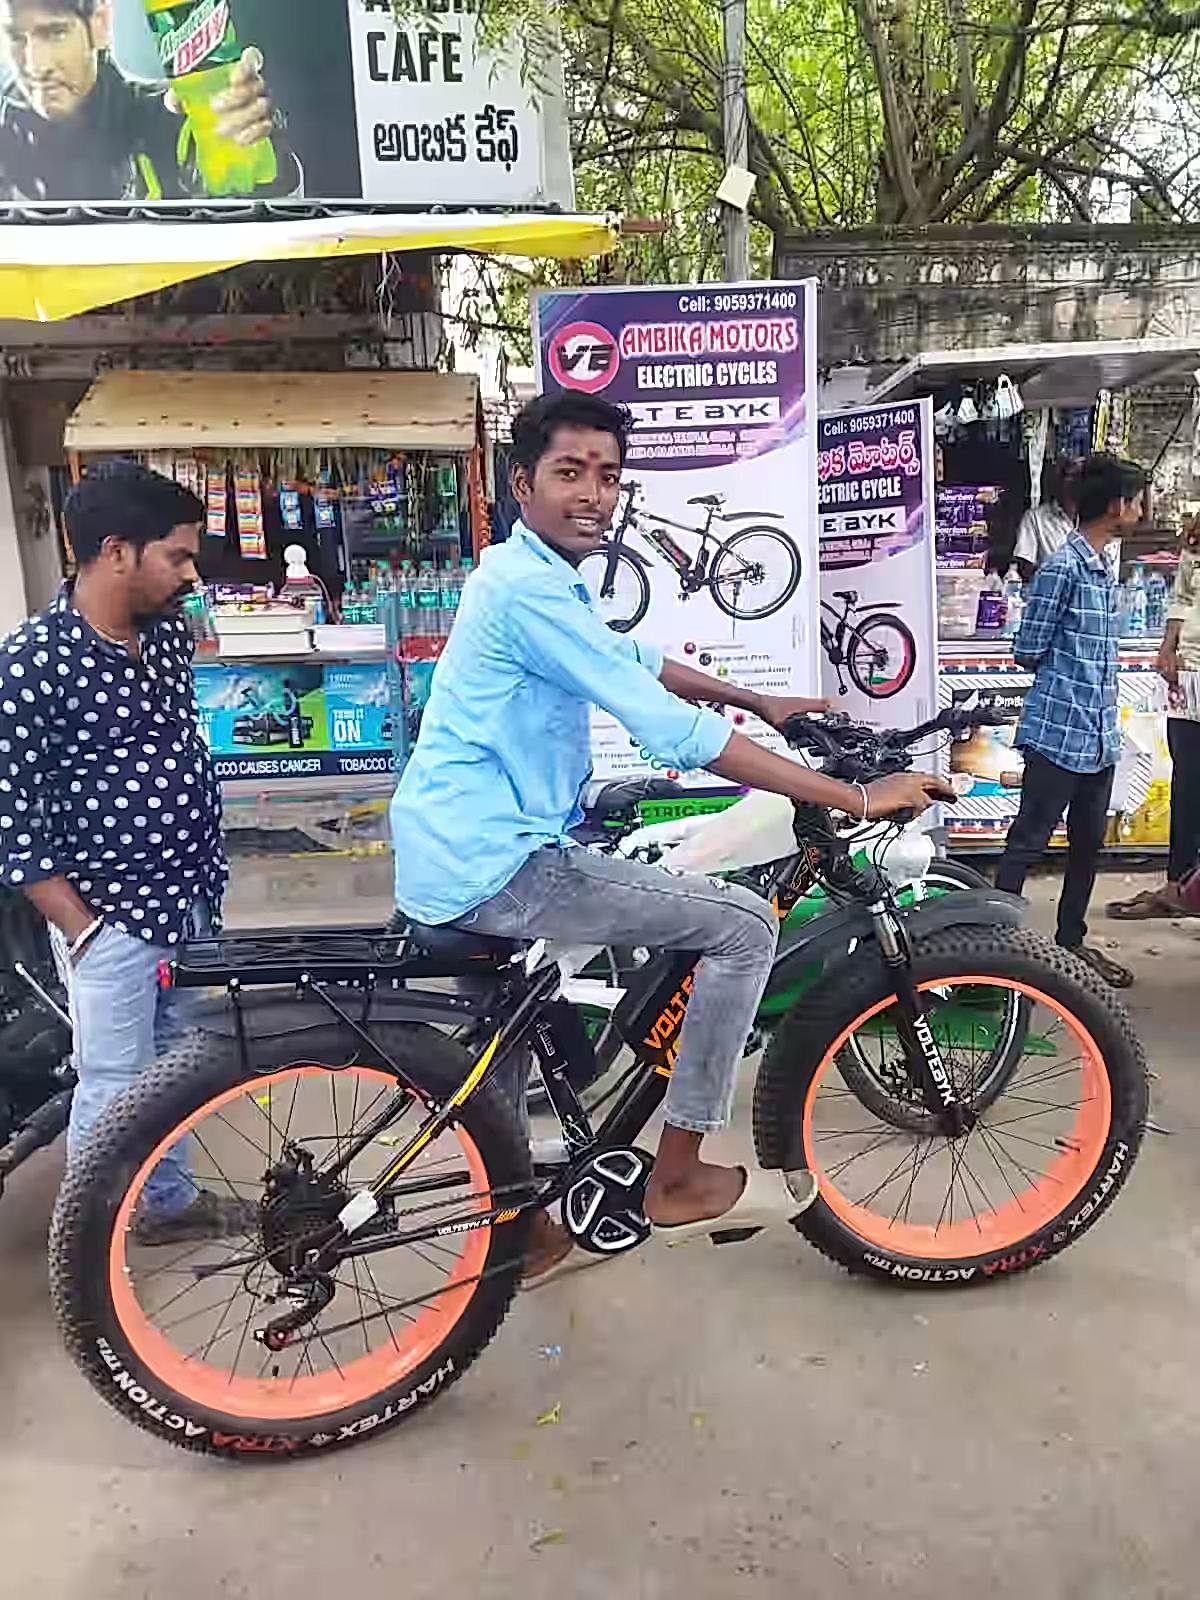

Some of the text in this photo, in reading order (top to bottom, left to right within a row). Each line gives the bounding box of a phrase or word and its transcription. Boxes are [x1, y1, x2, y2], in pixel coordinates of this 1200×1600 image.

[366, 31, 463, 82] CAFE
[678, 293, 797, 313] Cell: 9059371400
[621, 319, 798, 357] AMBIKA MOTORS
[637, 361, 777, 388] ELECTRIC CYCLES
[823, 409, 915, 436] Cell: 9059371400
[861, 476, 902, 500] CYCLE
[239, 760, 279, 774] CAUSES
[280, 757, 321, 772] CANCER
[339, 757, 387, 771] TOBACCO
[1068, 1141, 1129, 1233] HARTEX
[892, 1265, 976, 1282] ACTION
[112, 1371, 208, 1437] ACTION
[336, 1357, 455, 1441] HARTEX
